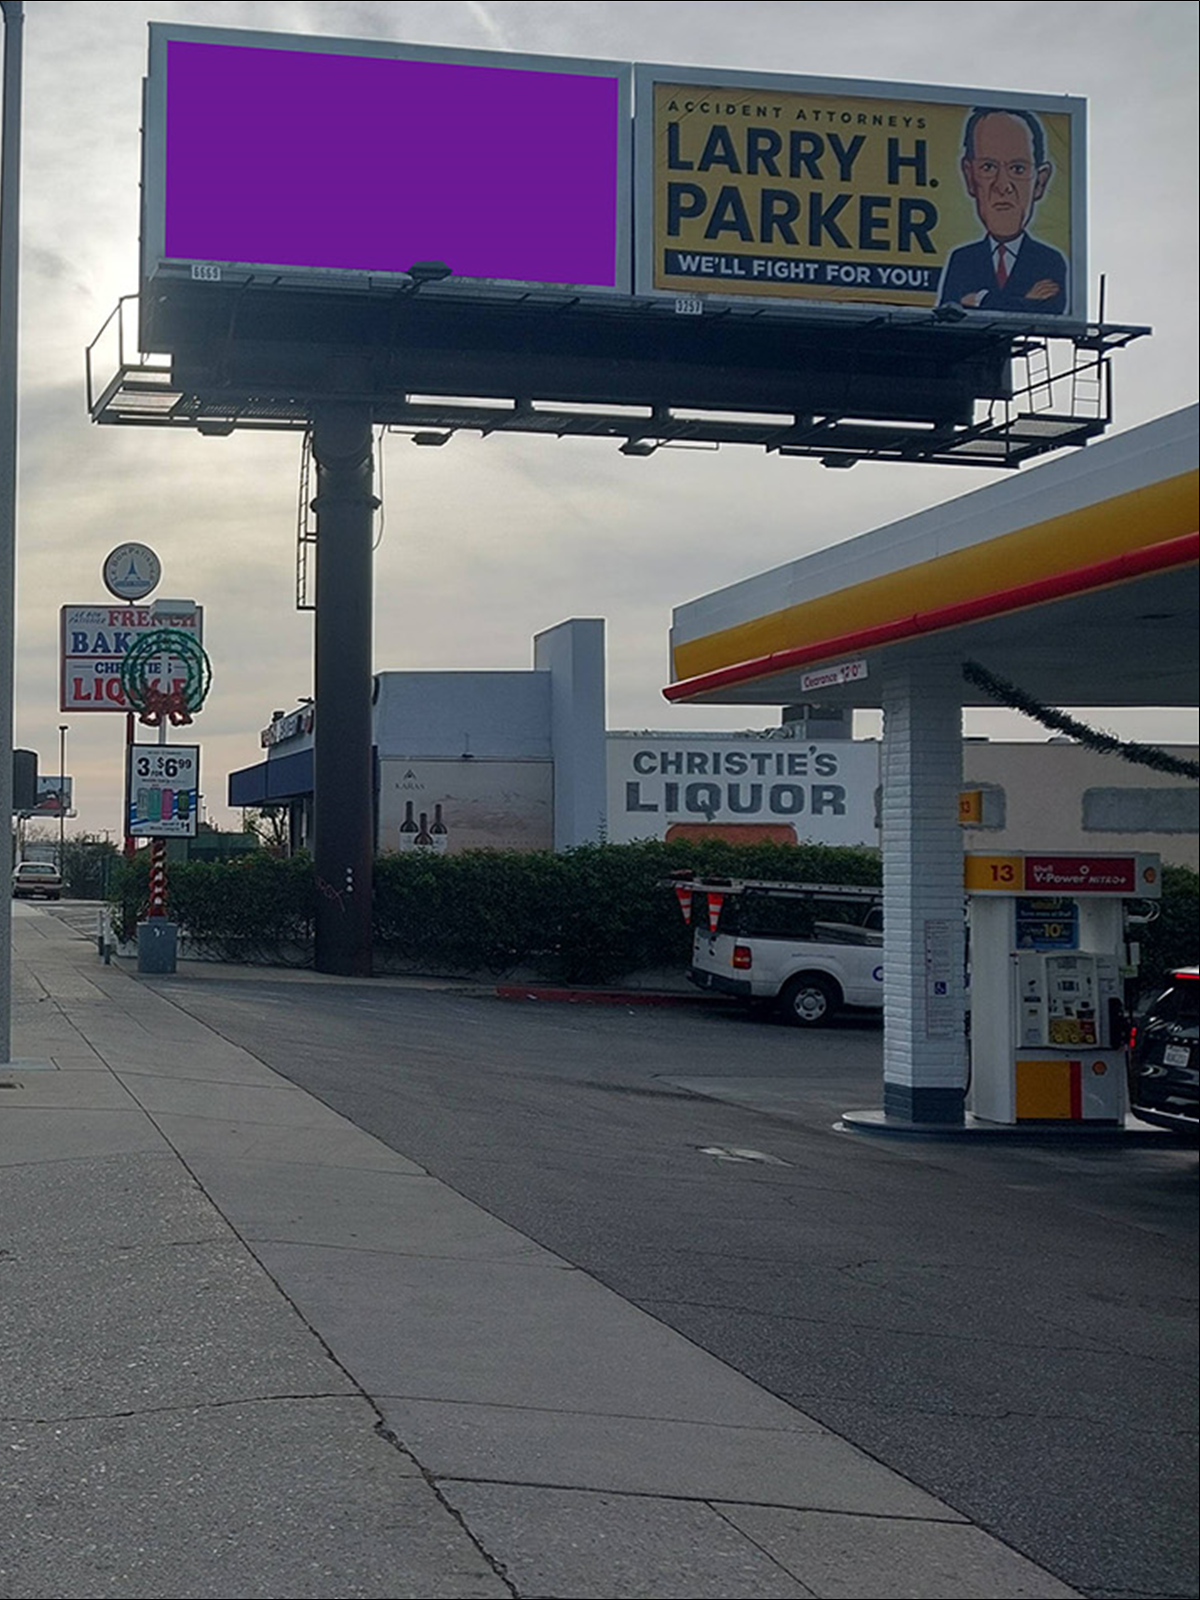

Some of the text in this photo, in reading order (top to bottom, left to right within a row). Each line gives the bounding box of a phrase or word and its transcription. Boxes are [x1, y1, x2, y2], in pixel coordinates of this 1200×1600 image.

[667, 100, 927, 129] ACCIDENT ATTORNEYS
[667, 121, 939, 188] LARRY H.
[667, 182, 938, 254] PARKER
[678, 255, 930, 288] WE'LL FIGHT FOR YOU!
[137, 757, 150, 777] 3
[633, 746, 838, 776] CHRISTIE'S
[626, 780, 847, 822] LIQUOR
[990, 865, 1014, 882] 13
[1033, 873, 1086, 884] V-Power
